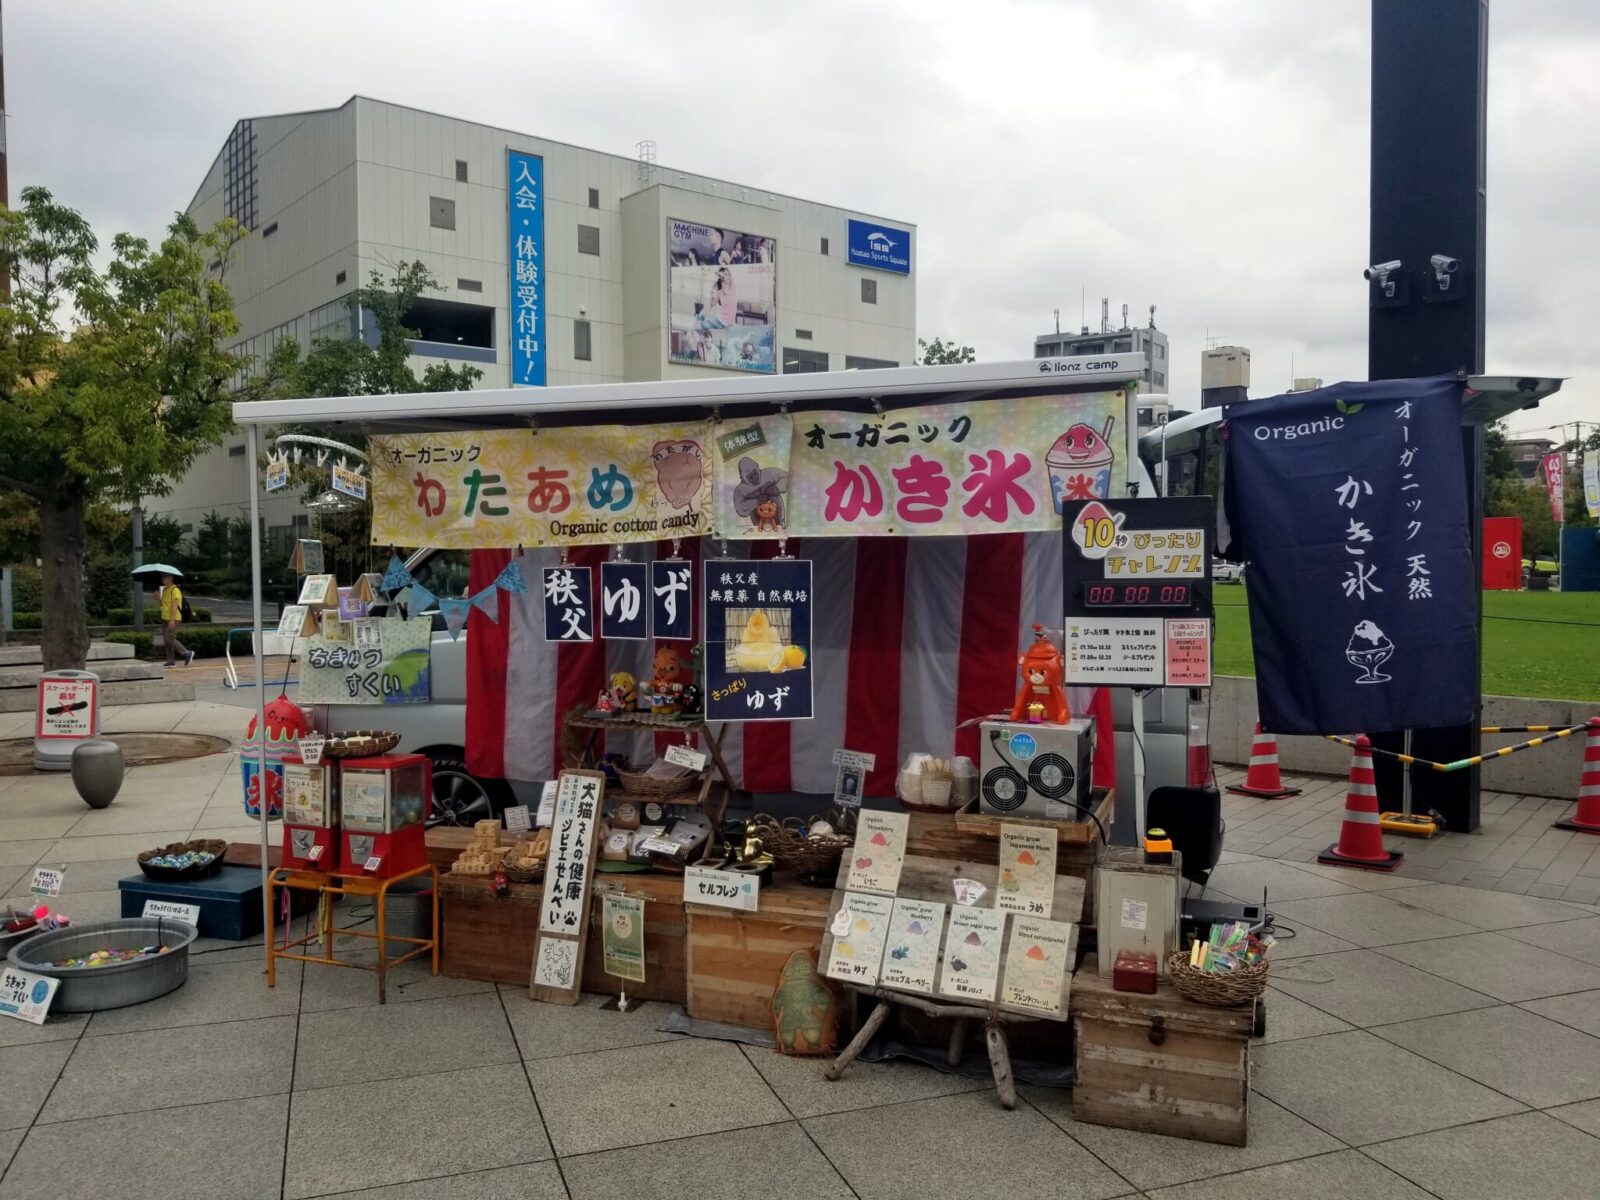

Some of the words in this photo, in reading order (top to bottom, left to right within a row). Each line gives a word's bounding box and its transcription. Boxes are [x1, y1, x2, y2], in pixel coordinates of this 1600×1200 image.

[673, 222, 709, 237] MACHINE
[673, 231, 692, 241] GYM
[870, 252, 889, 262] Sports
[1054, 362, 1081, 372] lionz
[1085, 360, 1119, 371] camp
[804, 414, 972, 450] オーガニック
[1254, 416, 1346, 441] Organic
[391, 444, 481, 464] オーガニック
[1394, 400, 1423, 542] オーガニック
[413, 464, 634, 517] わたあめ
[823, 448, 1036, 525] かき氷
[1061, 473, 1100, 500] 氷
[549, 519, 611, 538] Organic
[613, 518, 658, 535] cotton
[660, 511, 700, 532] candy
[1334, 475, 1384, 601] かき氷
[1108, 555, 1202, 574] チャレンジ
[720, 572, 759, 585] 秩父産
[1406, 553, 1433, 600] 天然
[544, 569, 592, 640] 秩父
[603, 578, 640, 623] ゆ
[654, 568, 691, 625] ず
[708, 589, 749, 603] 無農薬
[757, 589, 809, 603] 自然栽培
[1090, 587, 1114, 603] 00
[1125, 587, 1150, 603] 00
[1160, 586, 1186, 602] 00
[309, 647, 383, 669] ちきゅう
[346, 672, 400, 697] すくい
[711, 677, 746, 701] さっぱり
[746, 686, 790, 711] ゆず
[867, 824, 895, 833] Strawberry
[1003, 832, 1025, 840] Organic
[565, 783, 597, 901] 犬猫さんの健康
[549, 818, 574, 925] ジビエせんべい
[698, 882, 739, 898] セルフレジ
[901, 904, 919, 912] Organic
[910, 913, 933, 921] Blueberry
[1029, 901, 1045, 913] うめ
[1018, 931, 1033, 939] Blend
[1020, 924, 1040, 932] Organic
[5, 974, 27, 990] ちきゅう
[12, 990, 29, 1004] すくい
